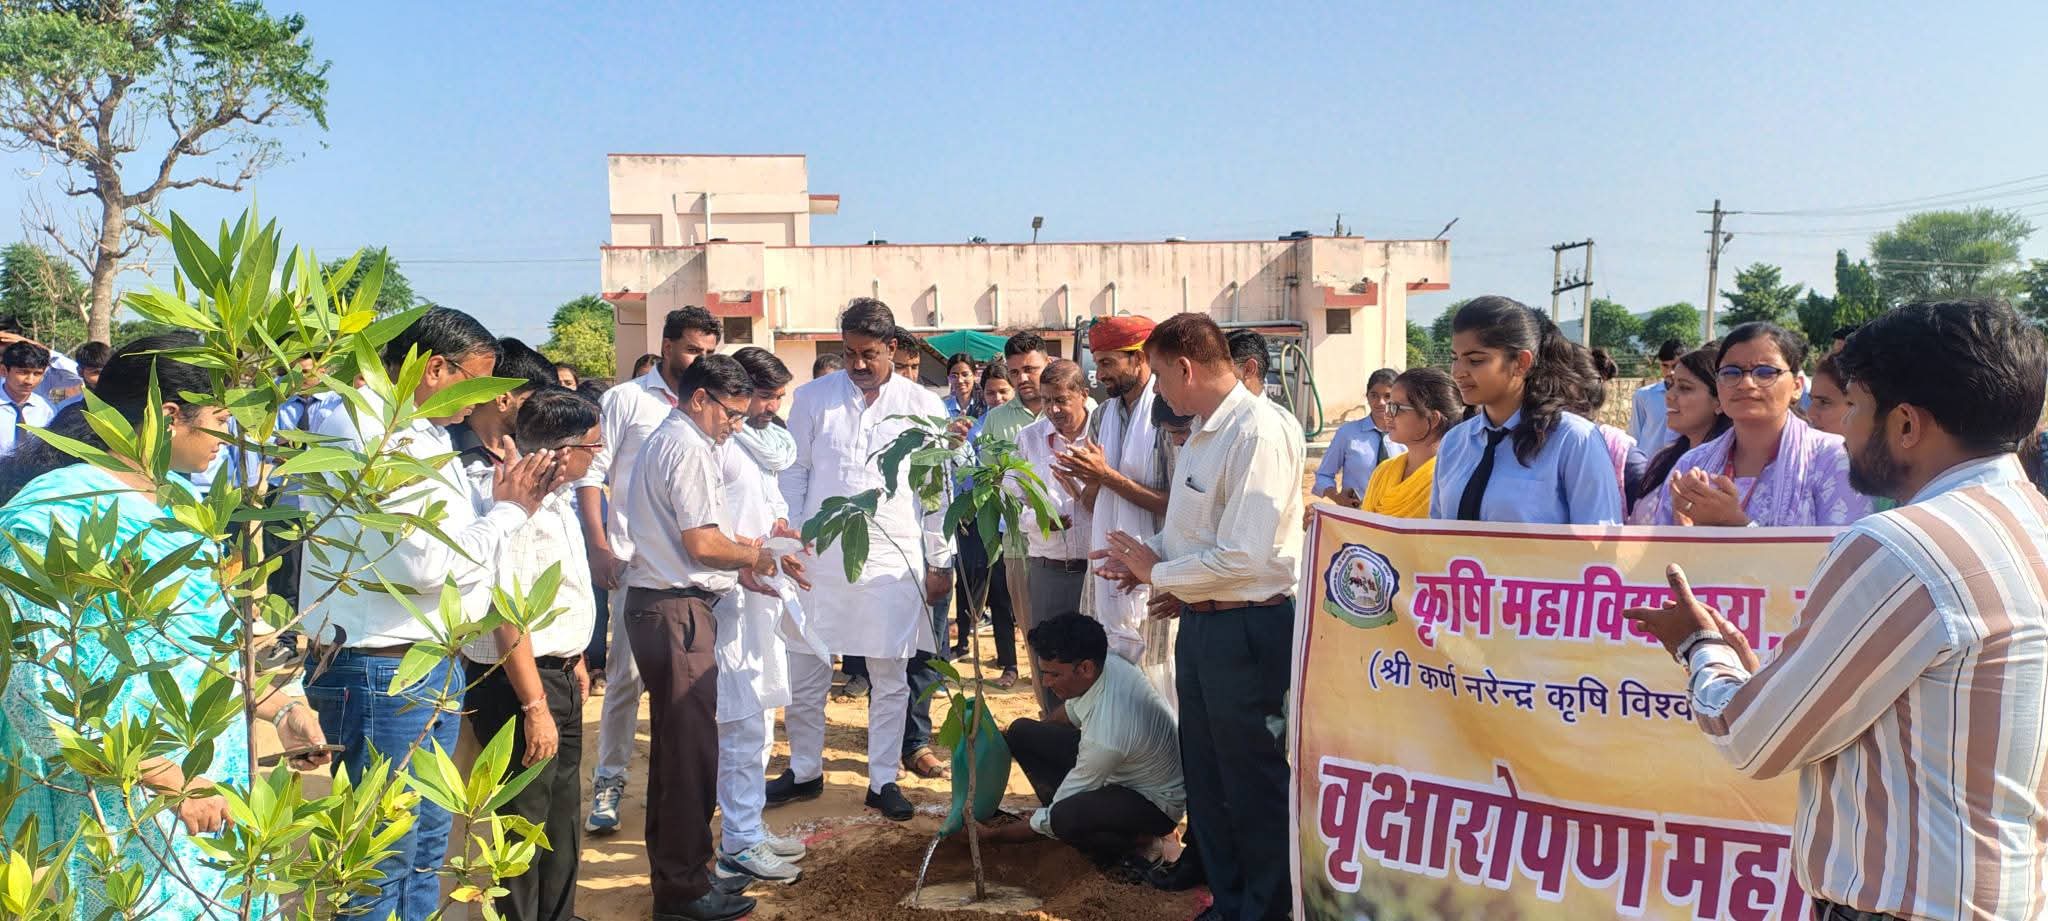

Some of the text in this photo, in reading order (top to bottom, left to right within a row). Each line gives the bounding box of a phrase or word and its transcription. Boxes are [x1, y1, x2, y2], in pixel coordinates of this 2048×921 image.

[1413, 559, 1496, 648] कृषि
[1370, 650, 1411, 688] (श्री
[1418, 664, 1457, 696] कर्ण
[1462, 669, 1536, 709] नरेन्द्र
[1545, 677, 1608, 722] कृषि
[1320, 763, 1655, 908] वृक्षारोपण
